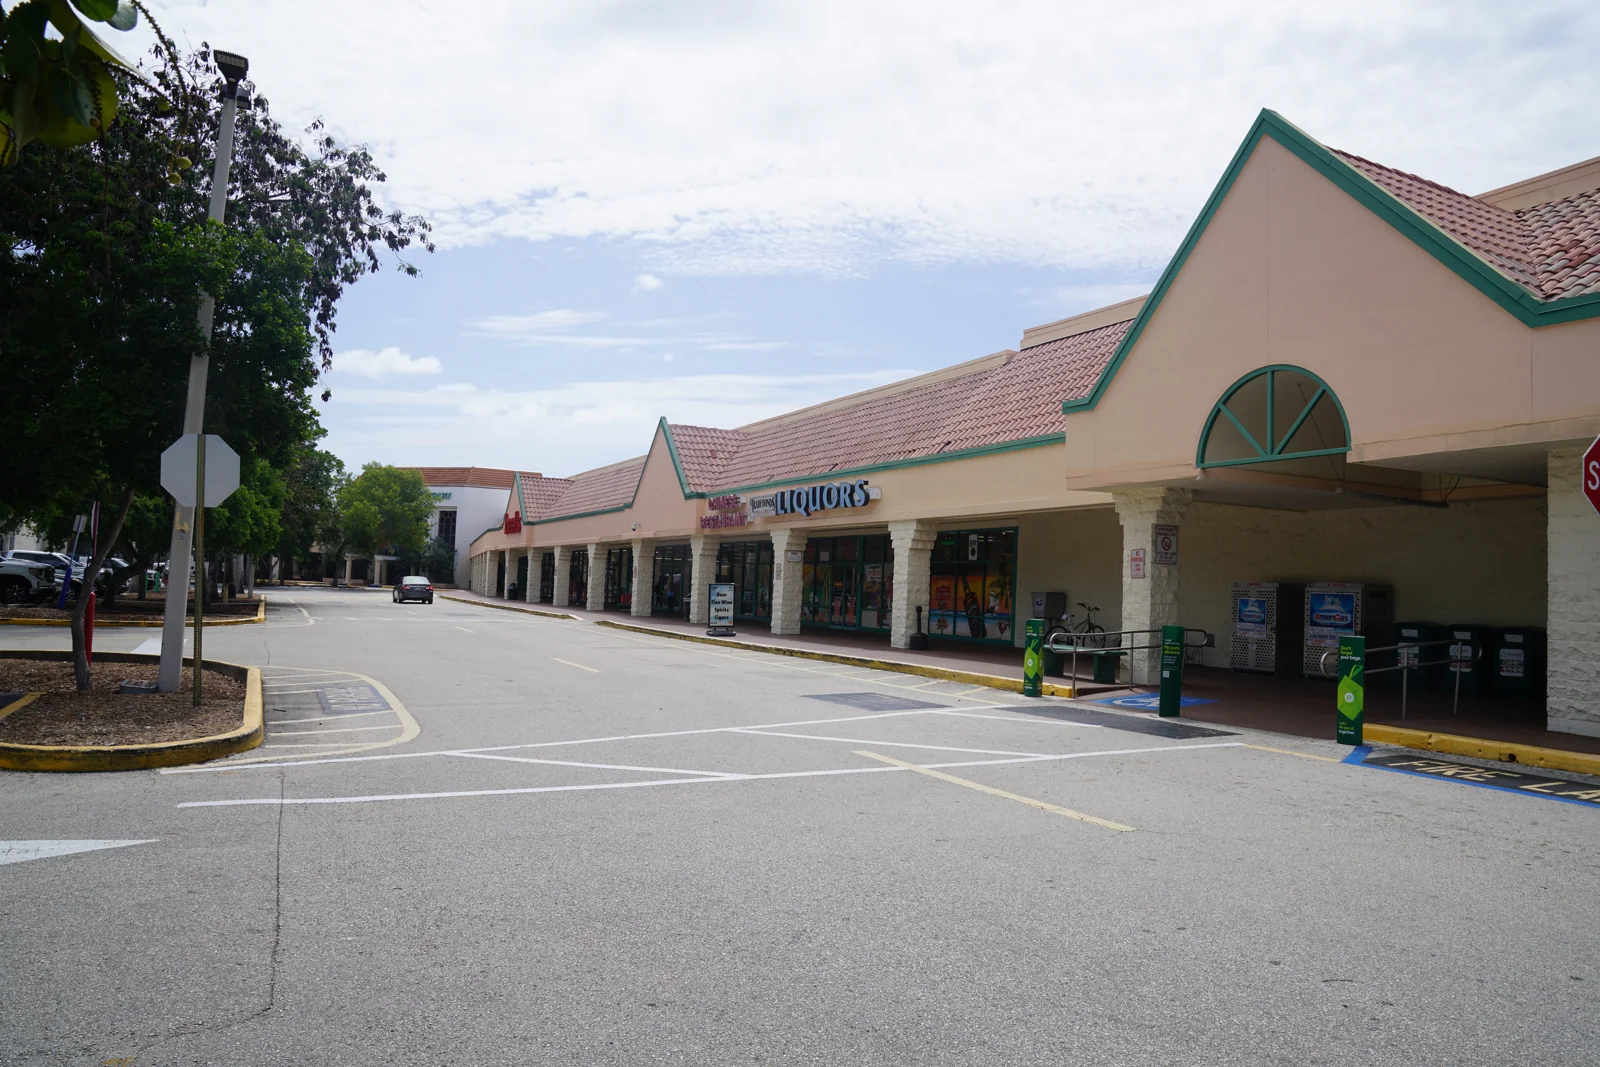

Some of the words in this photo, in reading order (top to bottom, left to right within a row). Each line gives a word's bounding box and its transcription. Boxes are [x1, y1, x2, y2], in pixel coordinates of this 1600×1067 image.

[708, 494, 741, 511] CHINESE
[776, 479, 870, 516] LIQUORS
[701, 512, 748, 529] RESTAURANT
[1314, 613, 1349, 622] AmeriGas
[1387, 759, 1521, 782] FIRE
[1518, 781, 1600, 803] LA
